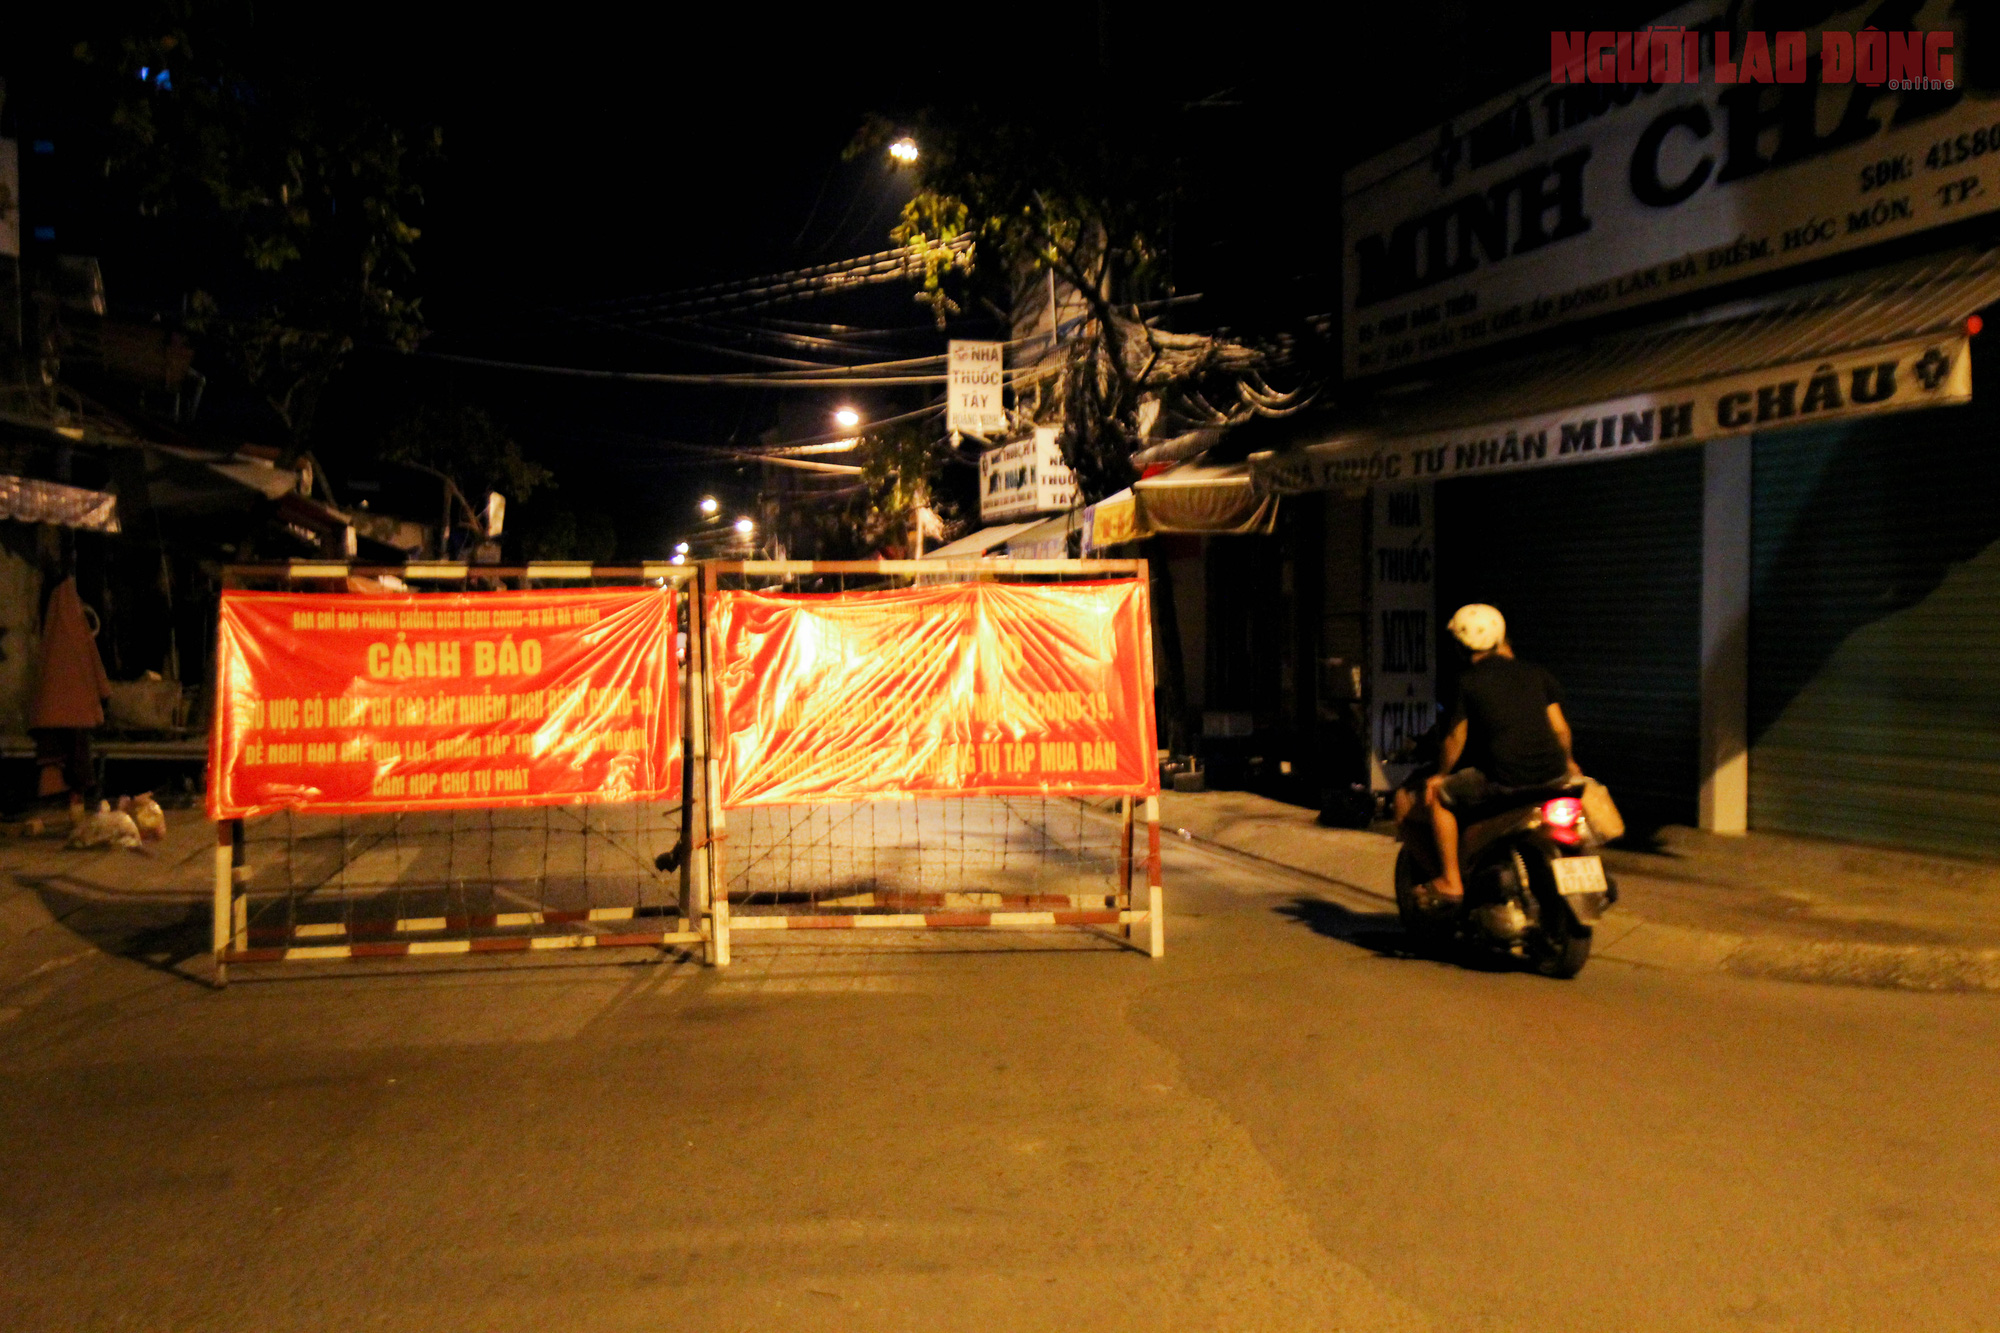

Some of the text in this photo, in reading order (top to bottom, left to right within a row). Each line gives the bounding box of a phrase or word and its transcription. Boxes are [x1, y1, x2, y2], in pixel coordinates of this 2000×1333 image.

[1355, 145, 1592, 308] MINH
[962, 390, 988, 409] TÂY
[1455, 429, 1548, 469] NHÂN
[1559, 400, 1696, 455] MINH
[1716, 361, 1900, 429] CHÂU
[368, 631, 543, 678] CẢNH BÁO
[1382, 610, 1427, 672] MINH
[269, 696, 300, 734] VỰC
[304, 691, 324, 729] CÓ
[328, 697, 367, 728] NGUY
[371, 694, 392, 726] CƠ
[396, 697, 426, 726] CAO
[430, 690, 456, 725] LÂY
[459, 684, 507, 724] NHIỄM
[511, 690, 545, 725] DỊCH
[245, 736, 264, 765] ĐỀ
[268, 743, 302, 767] NGHỊ
[307, 742, 336, 766] HẠN
[373, 741, 401, 764] QUA
[486, 731, 511, 759] TẬP
[980, 742, 999, 780] TỤ
[1004, 738, 1036, 780] TẬP
[1041, 741, 1077, 771] MUA
[1083, 735, 1117, 771] BÁN
[410, 769, 437, 799] HỌP
[442, 770, 470, 797] CHỢ
[474, 768, 491, 796] TỰ
[496, 764, 529, 791] PHÁT
